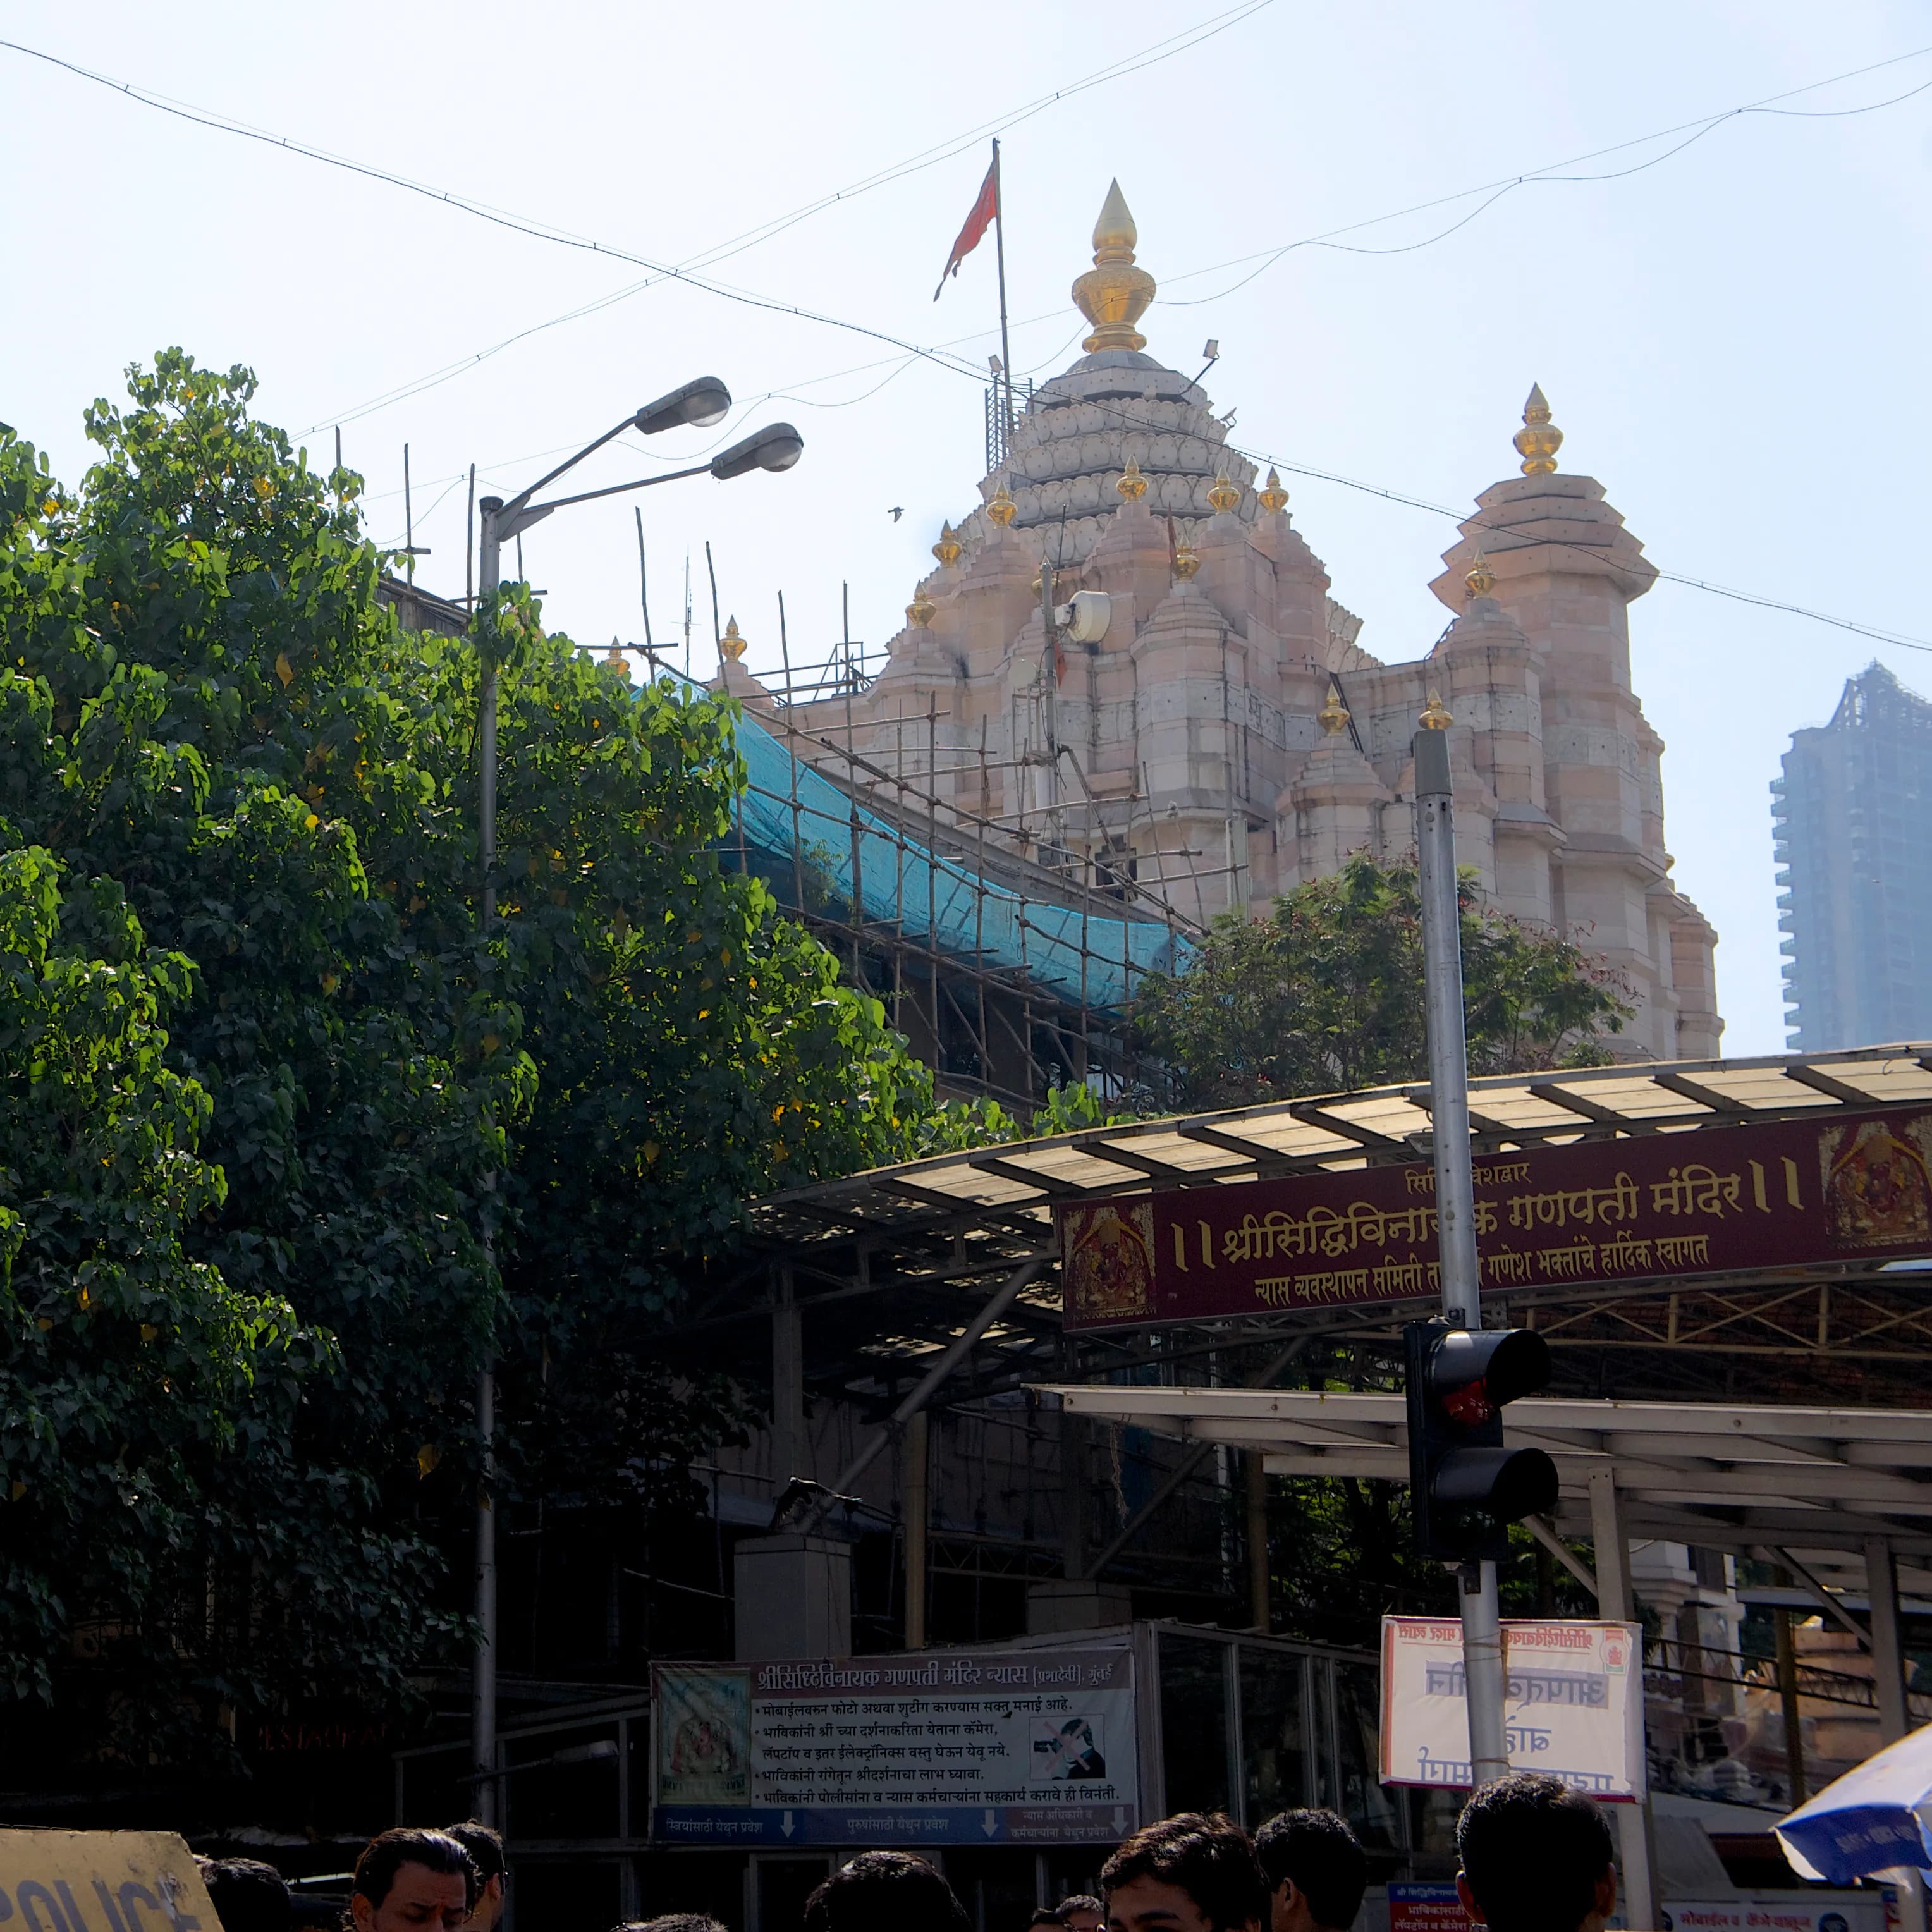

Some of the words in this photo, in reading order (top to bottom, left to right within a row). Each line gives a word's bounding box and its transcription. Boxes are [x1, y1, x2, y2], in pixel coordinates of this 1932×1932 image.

[1508, 1171, 1639, 1230] गणपती
[1650, 1165, 1743, 1219] मंदिर
[1254, 1275, 1291, 1307] न्यास
[1294, 1268, 1367, 1304] व्यवस्थापन
[1372, 1252, 1423, 1295] समिती
[1488, 1244, 1532, 1283] गणेश
[1538, 1234, 1597, 1277] भक्तांचे
[1599, 1230, 1652, 1276] हार्दिक
[1654, 1234, 1710, 1271] स्वागत
[885, 1661, 939, 1687] गणपती
[944, 1660, 983, 1685] मंदिर
[987, 1665, 1029, 1684] न्यास
[831, 1700, 858, 1714] फोटो
[862, 1703, 895, 1714] अथवा
[932, 1701, 980, 1713] करण्यास
[983, 1701, 1010, 1713] सक्त
[1012, 1698, 1042, 1714] मनाई
[1046, 1696, 1072, 1711] आहे.
[763, 1723, 815, 1738] भाविकांनी
[836, 1726, 857, 1737] च्या
[860, 1721, 923, 1737] दर्शनाकरिता
[926, 1720, 960, 1735] येताना
[762, 1746, 801, 1760] लॅपटॉप
[803, 1749, 812, 1759] व
[815, 1748, 835, 1761] इतर
[908, 1747, 932, 1762] वस्तु
[935, 1742, 963, 1758] घेऊन
[966, 1742, 986, 1761] येवू
[987, 1742, 1010, 1758] नये.
[762, 1768, 816, 1782] भाविकांनी
[818, 1766, 852, 1785] रांगेतून
[857, 1765, 916, 1782] श्रीदर्शनाचा
[919, 1768, 945, 1780] लाभ
[764, 1789, 816, 1804] भाविकांनी
[818, 1788, 870, 1804] पोलीसांना
[873, 1792, 882, 1802] व
[885, 1792, 913, 1803] न्यास
[984, 1786, 1026, 1804] सहकार्य
[1030, 1788, 1061, 1802] करावे
[1064, 1787, 1077, 1803] ही
[1022, 1810, 1044, 1821] न्यास
[1046, 1807, 1083, 1821] अधिकारी
[1085, 1810, 1093, 1820] व
[740, 1818, 764, 1833] प्रवेश
[923, 1816, 950, 1831] प्रवेश
[1087, 1824, 1108, 1838] प्रवेश
